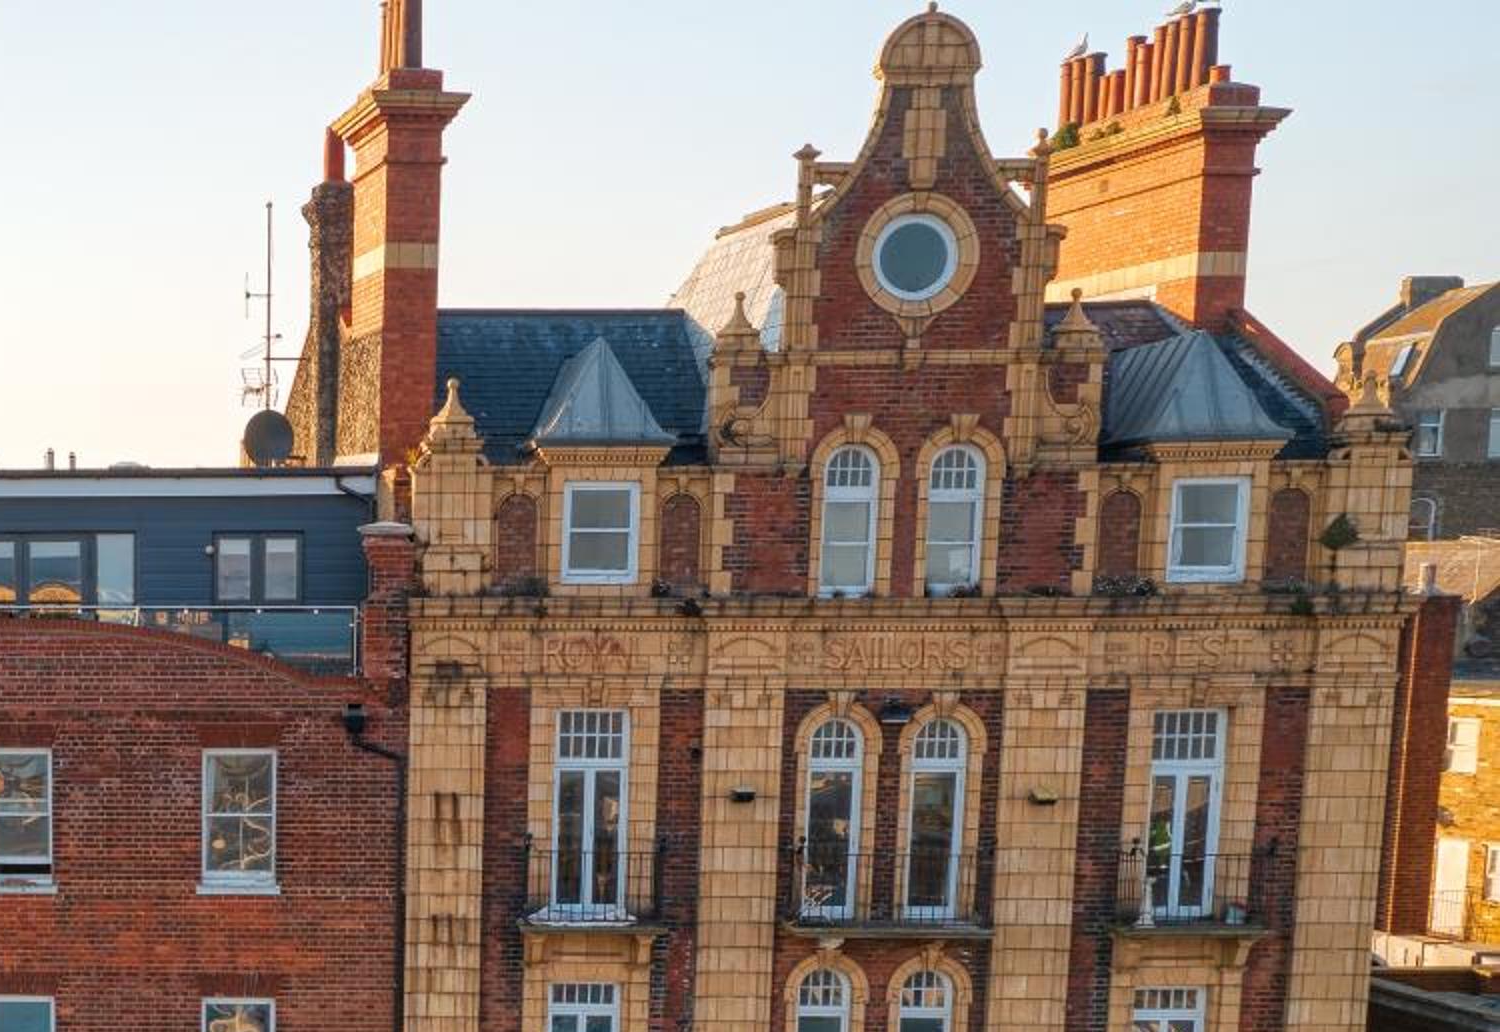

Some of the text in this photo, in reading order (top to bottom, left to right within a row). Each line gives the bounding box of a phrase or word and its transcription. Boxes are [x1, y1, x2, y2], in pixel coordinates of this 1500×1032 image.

[543, 634, 1254, 671] ROYAL SAILORS REST
